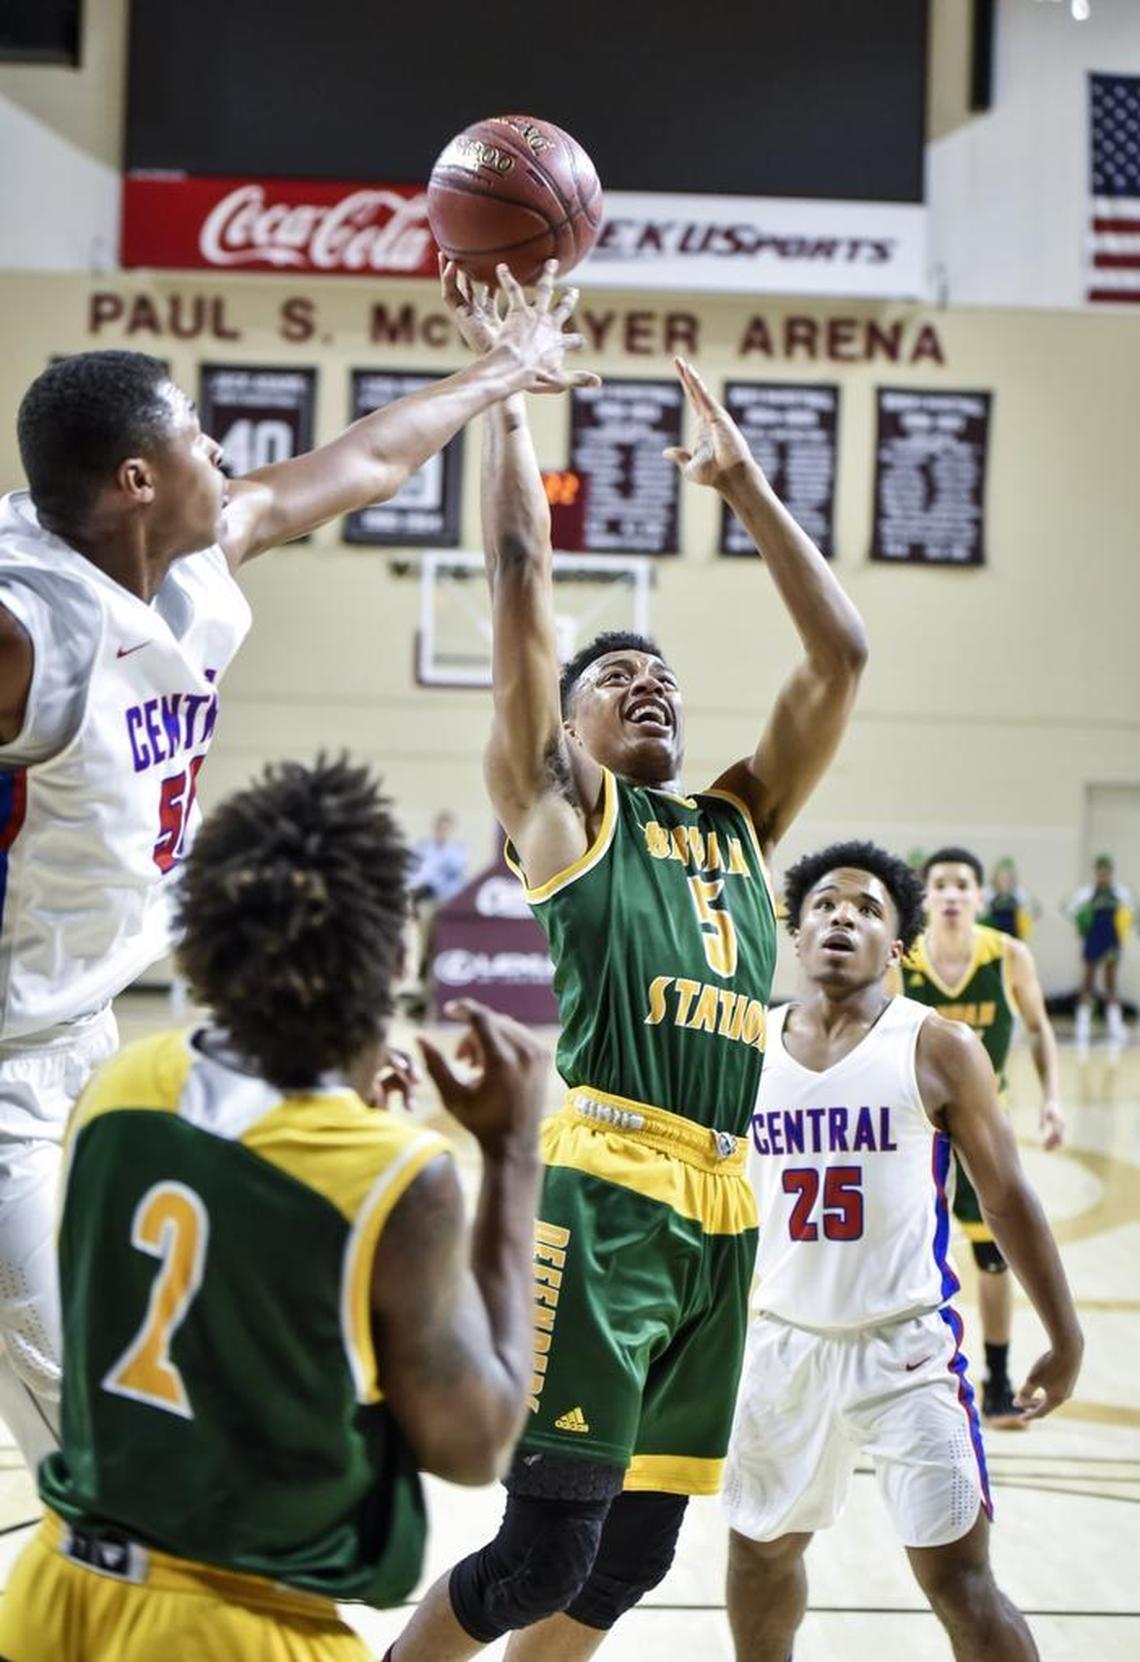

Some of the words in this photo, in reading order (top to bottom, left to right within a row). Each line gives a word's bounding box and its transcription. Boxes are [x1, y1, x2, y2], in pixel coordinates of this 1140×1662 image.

[201, 184, 432, 270] Coca-Cola
[90, 294, 242, 341] PAUL
[278, 297, 334, 345] S.
[369, 303, 699, 356] McYER
[739, 314, 945, 365] ARENA
[153, 754, 207, 875] 5
[688, 875, 738, 979] 5
[751, 1107, 898, 1155] CENTRAL
[782, 1165, 864, 1242] 25
[101, 1180, 210, 1420] 2
